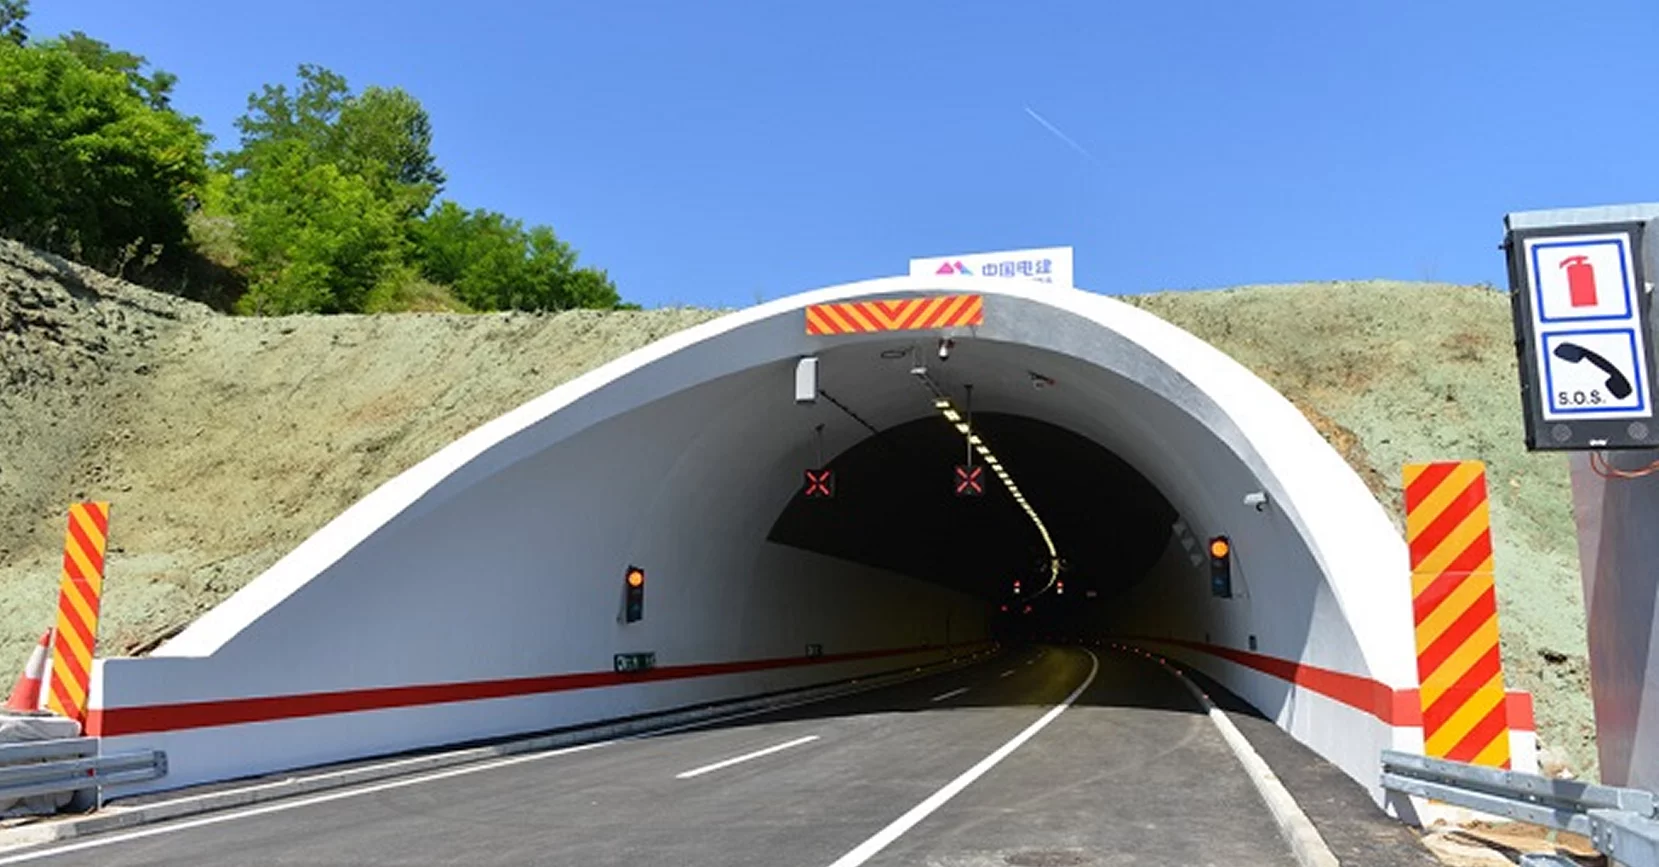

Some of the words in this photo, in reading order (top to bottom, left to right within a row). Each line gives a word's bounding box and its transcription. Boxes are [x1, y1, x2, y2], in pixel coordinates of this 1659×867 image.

[982, 259, 1052, 277] 中国电建
[1558, 389, 1607, 405] S.O.S.
